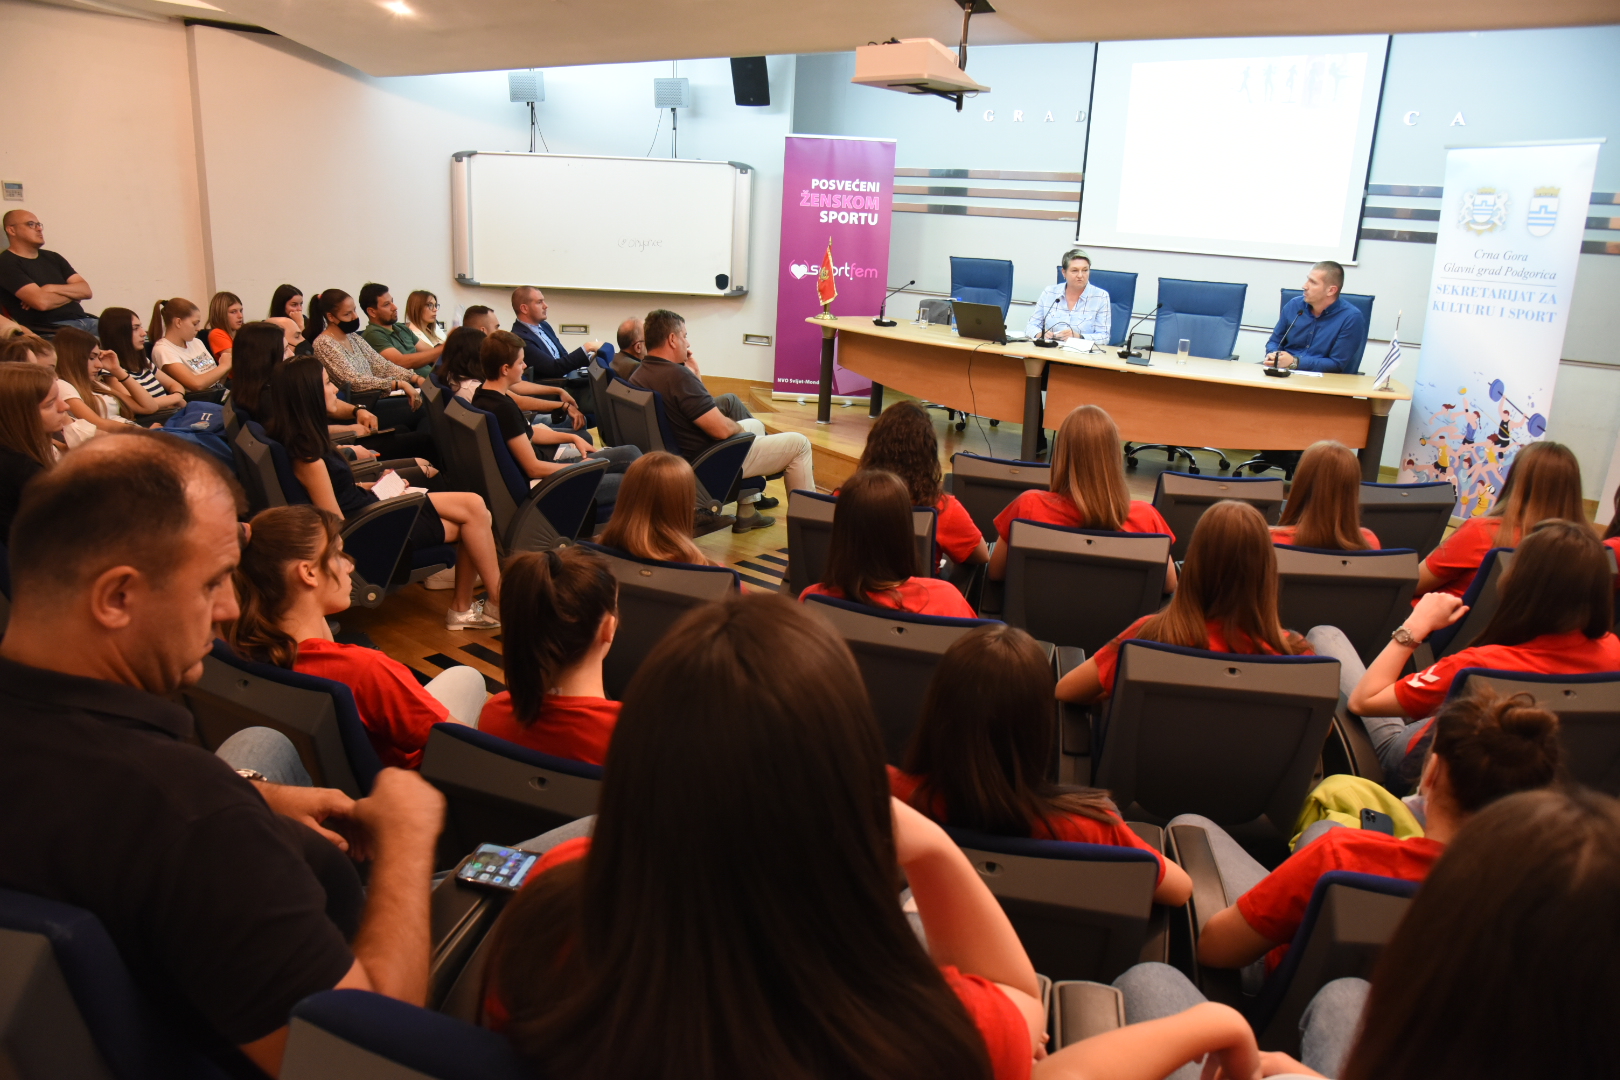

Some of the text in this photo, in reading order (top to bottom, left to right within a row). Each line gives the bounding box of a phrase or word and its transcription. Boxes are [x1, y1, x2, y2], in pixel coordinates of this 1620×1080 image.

[811, 178, 880, 193] POSVEĆENI
[799, 189, 880, 211] ŽENSKOM
[819, 210, 879, 226] SPORTU
[1474, 248, 1529, 262] Crna Gora
[1443, 262, 1557, 281] Glavni grad Podgorica
[1435, 283, 1558, 305] SEKRETARIJAT ZA
[1432, 300, 1558, 323] KULTURU I SPORT
